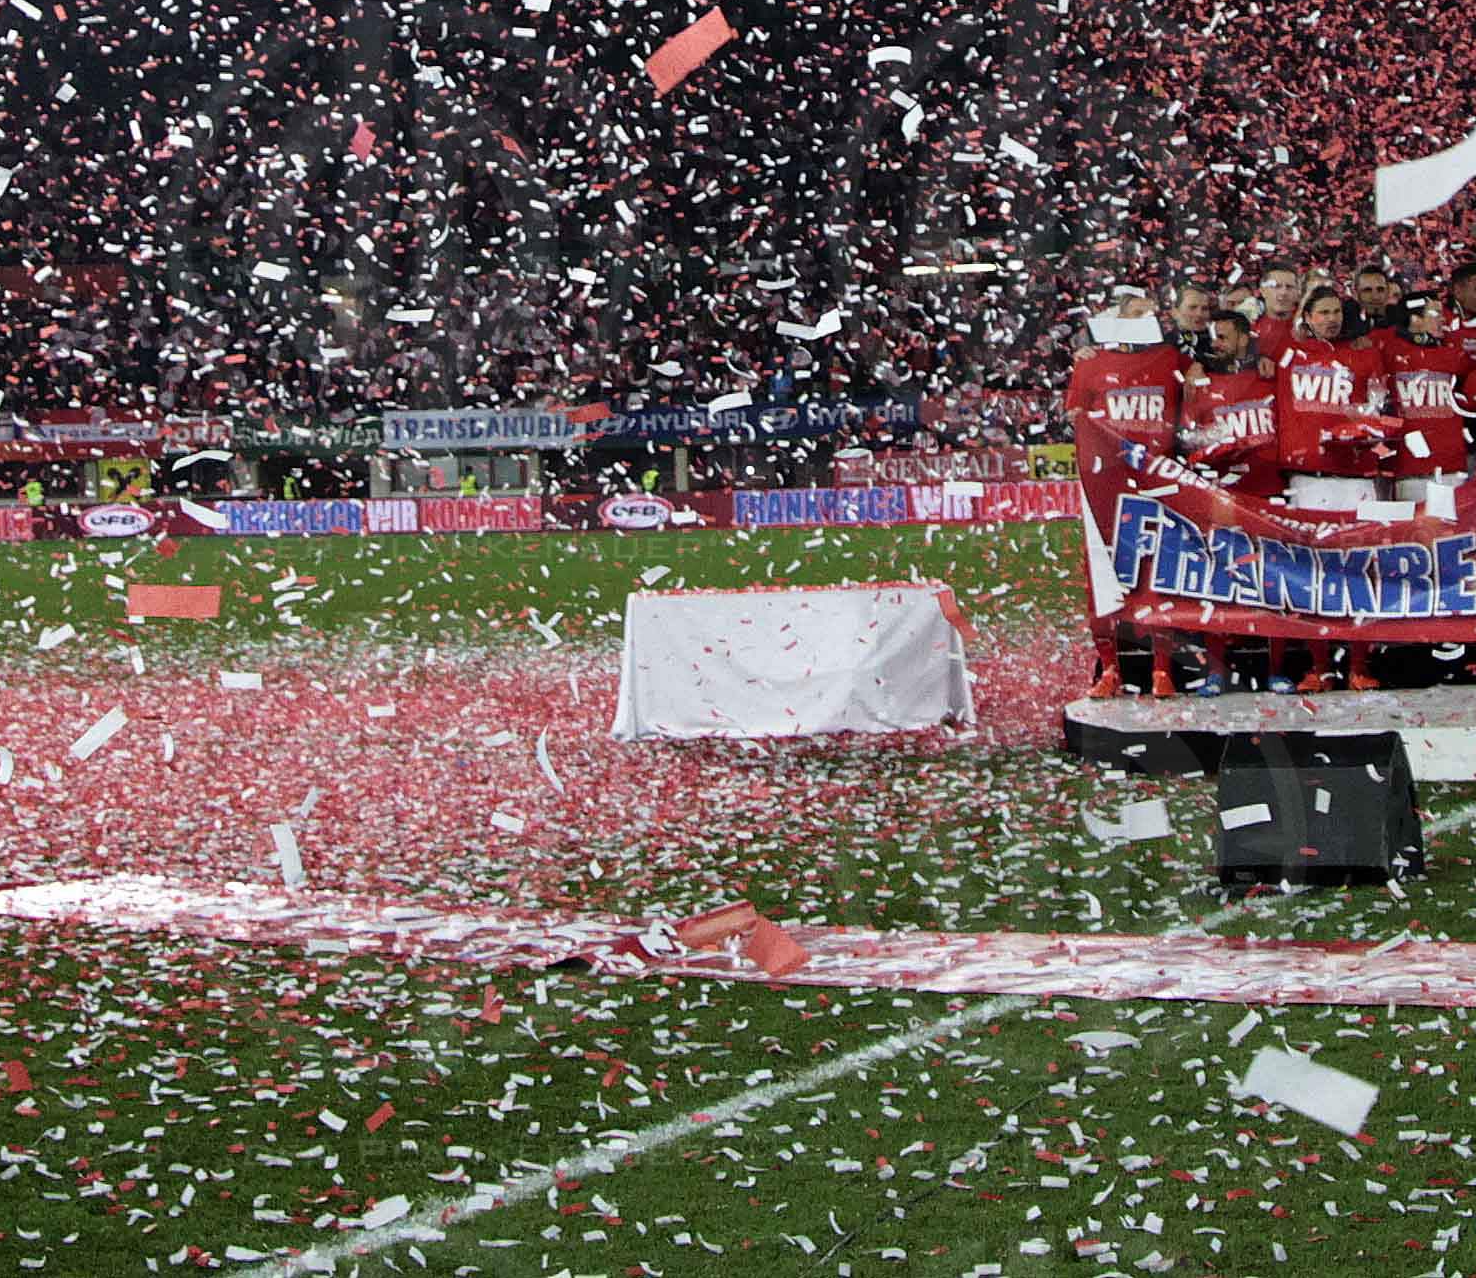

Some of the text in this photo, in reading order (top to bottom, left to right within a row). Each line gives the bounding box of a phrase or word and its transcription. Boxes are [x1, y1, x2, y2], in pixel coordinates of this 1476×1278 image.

[1291, 372, 1354, 404] WIR
[1107, 393, 1165, 422] WIR
[366, 499, 418, 532] WIR
